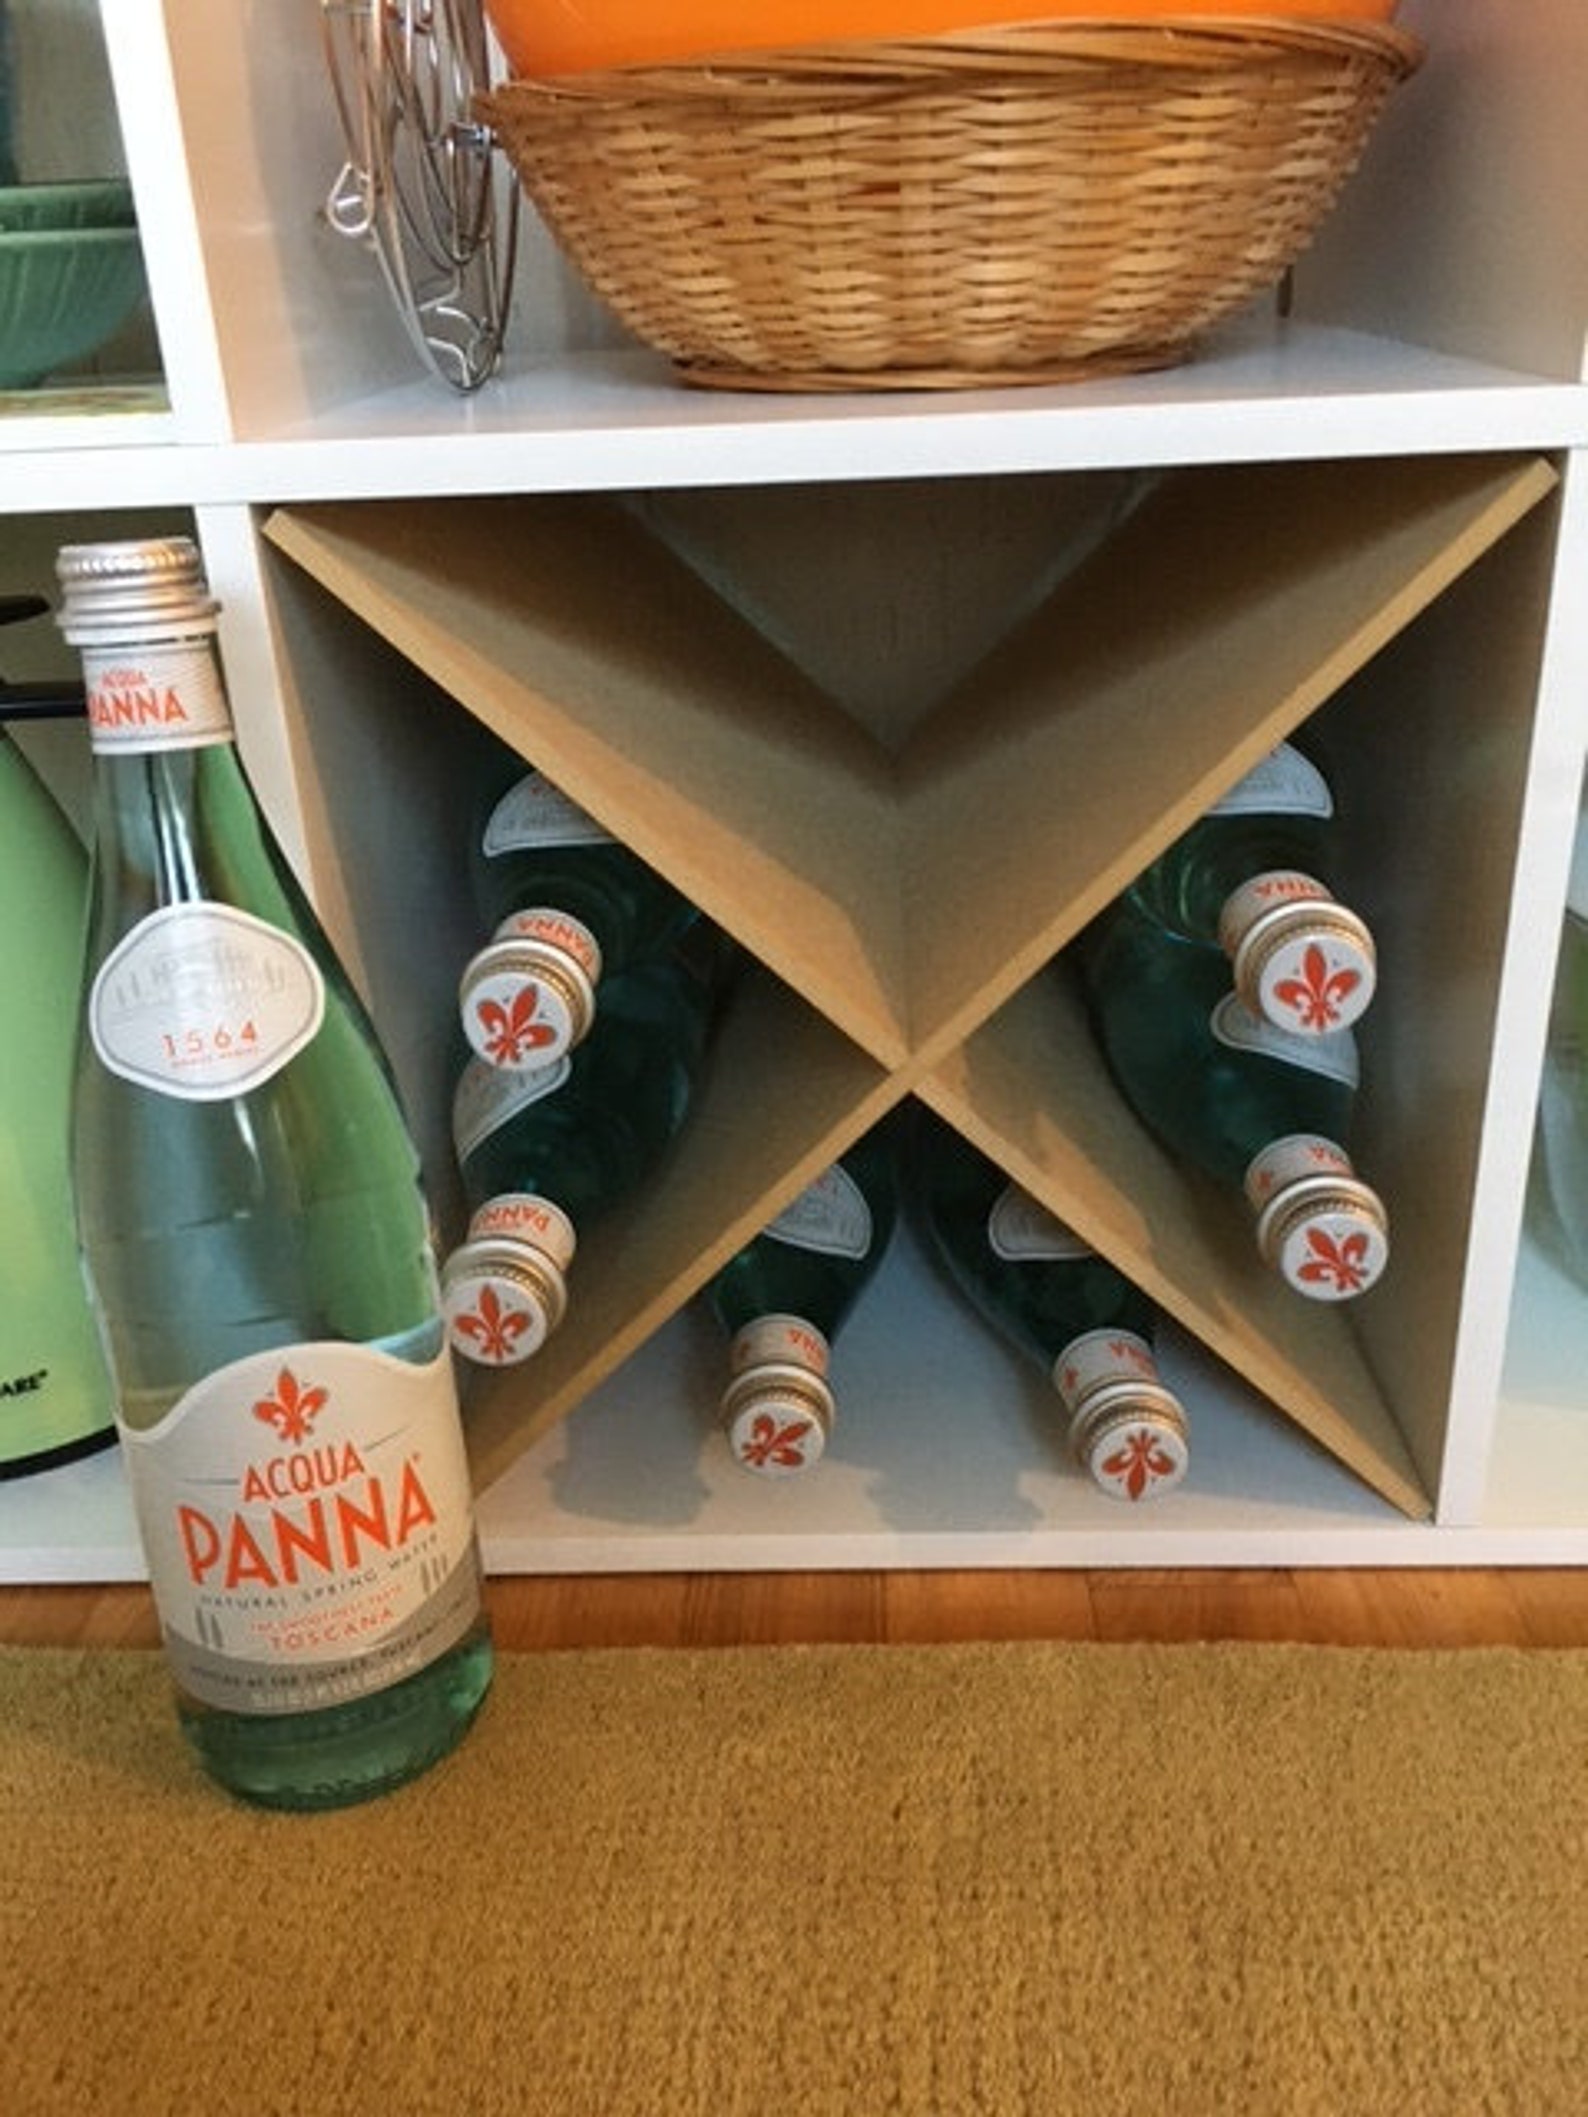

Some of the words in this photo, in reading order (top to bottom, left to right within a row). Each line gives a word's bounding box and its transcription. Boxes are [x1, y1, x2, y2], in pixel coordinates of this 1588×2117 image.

[162, 1020, 257, 1058] 1564
[243, 1442, 365, 1503] ACQUA
[175, 1458, 437, 1590] PANNA
[200, 1592, 290, 1610] NATURAL
[301, 1570, 378, 1603] SPRING
[267, 1606, 394, 1652] TOSCANA
